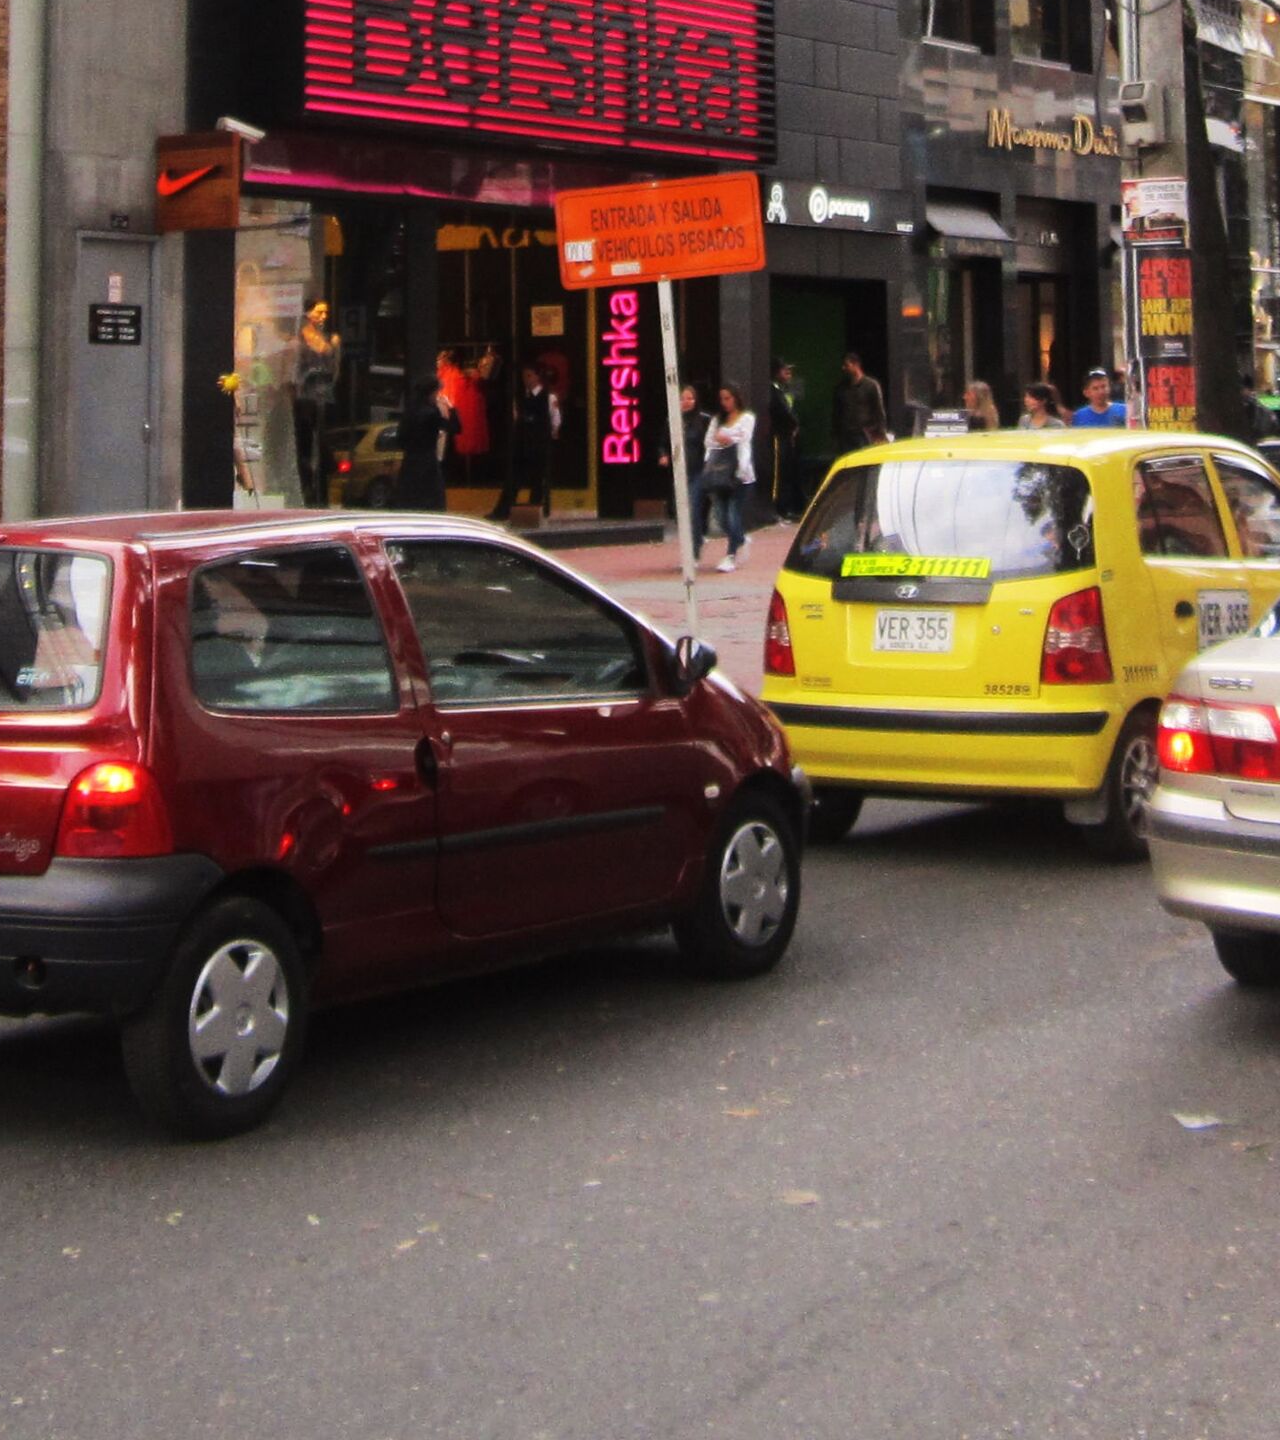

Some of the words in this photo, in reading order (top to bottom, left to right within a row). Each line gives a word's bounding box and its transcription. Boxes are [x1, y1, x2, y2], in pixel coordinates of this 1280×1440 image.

[591, 204, 656, 231] ENTRADA
[660, 202, 669, 222] Y
[673, 197, 722, 223] SALIDA
[599, 234, 674, 261] VEHICULOS
[680, 226, 745, 255] PESADOS
[602, 290, 640, 464] Bershka
[878, 616, 910, 640] VER
[915, 616, 948, 640] 355
